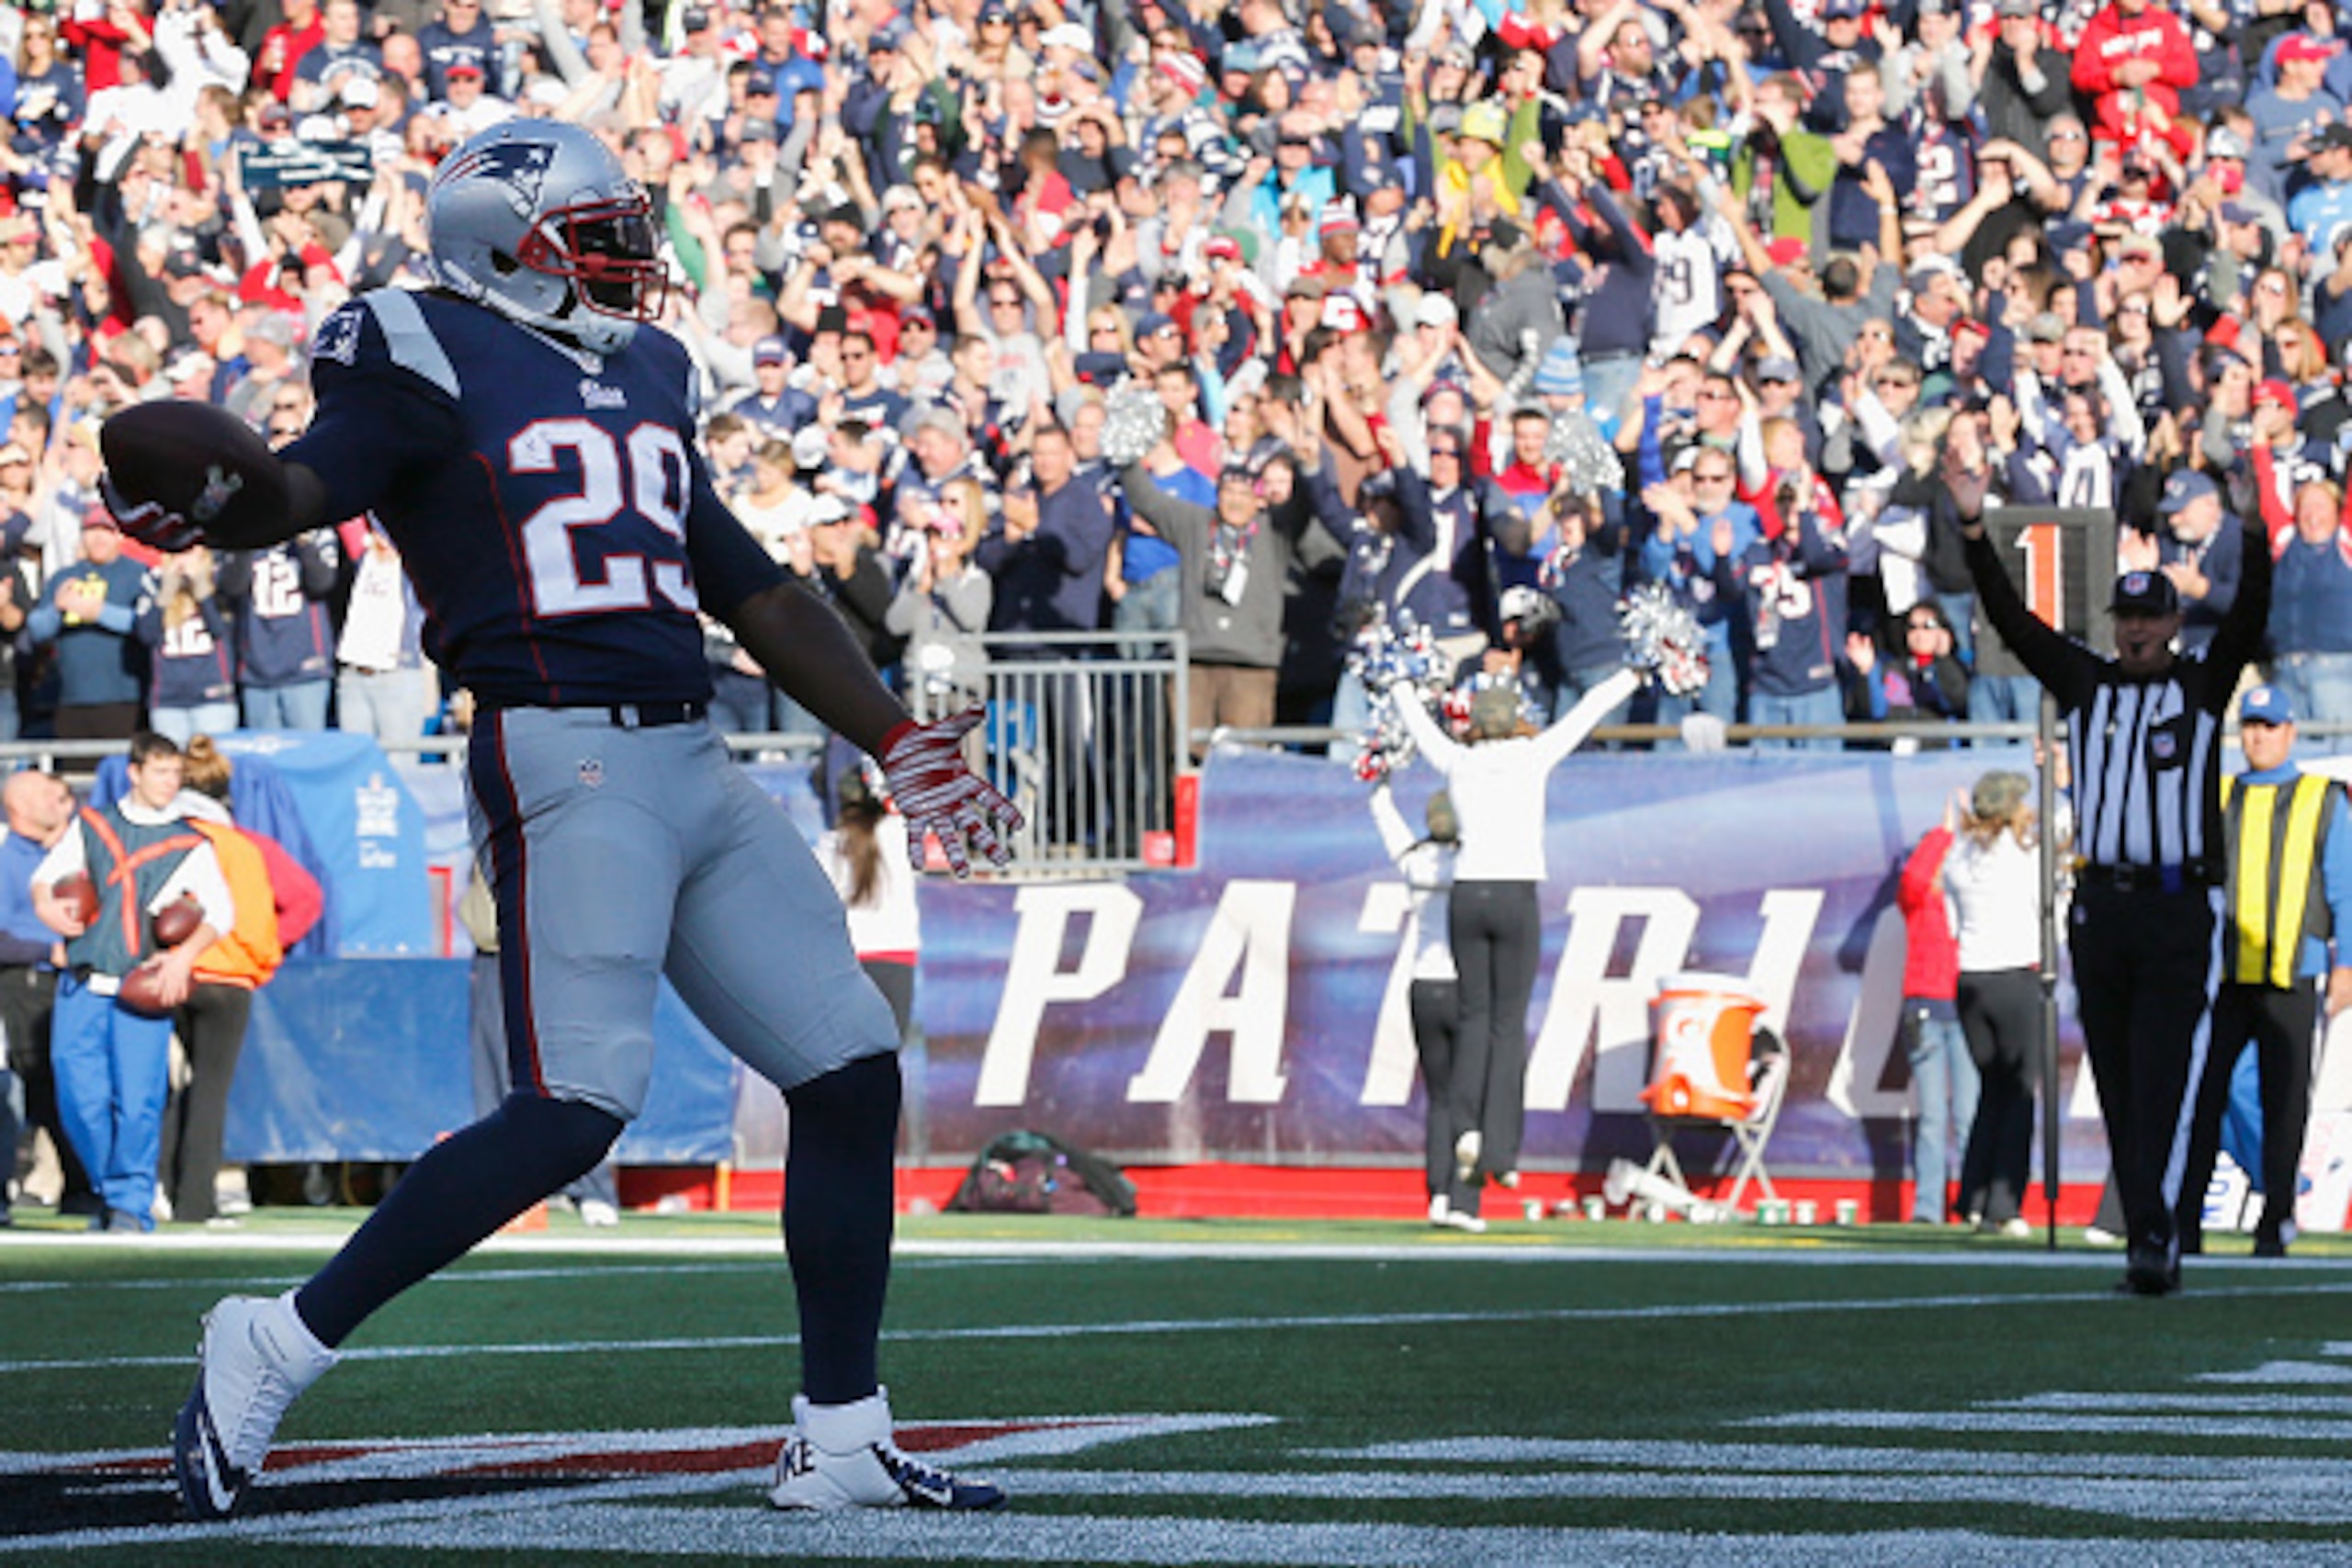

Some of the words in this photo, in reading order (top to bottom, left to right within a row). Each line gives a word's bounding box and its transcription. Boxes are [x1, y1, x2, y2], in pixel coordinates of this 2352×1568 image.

[507, 415, 700, 619] 29
[252, 555, 304, 618] 12
[2014, 522, 2065, 634] 1
